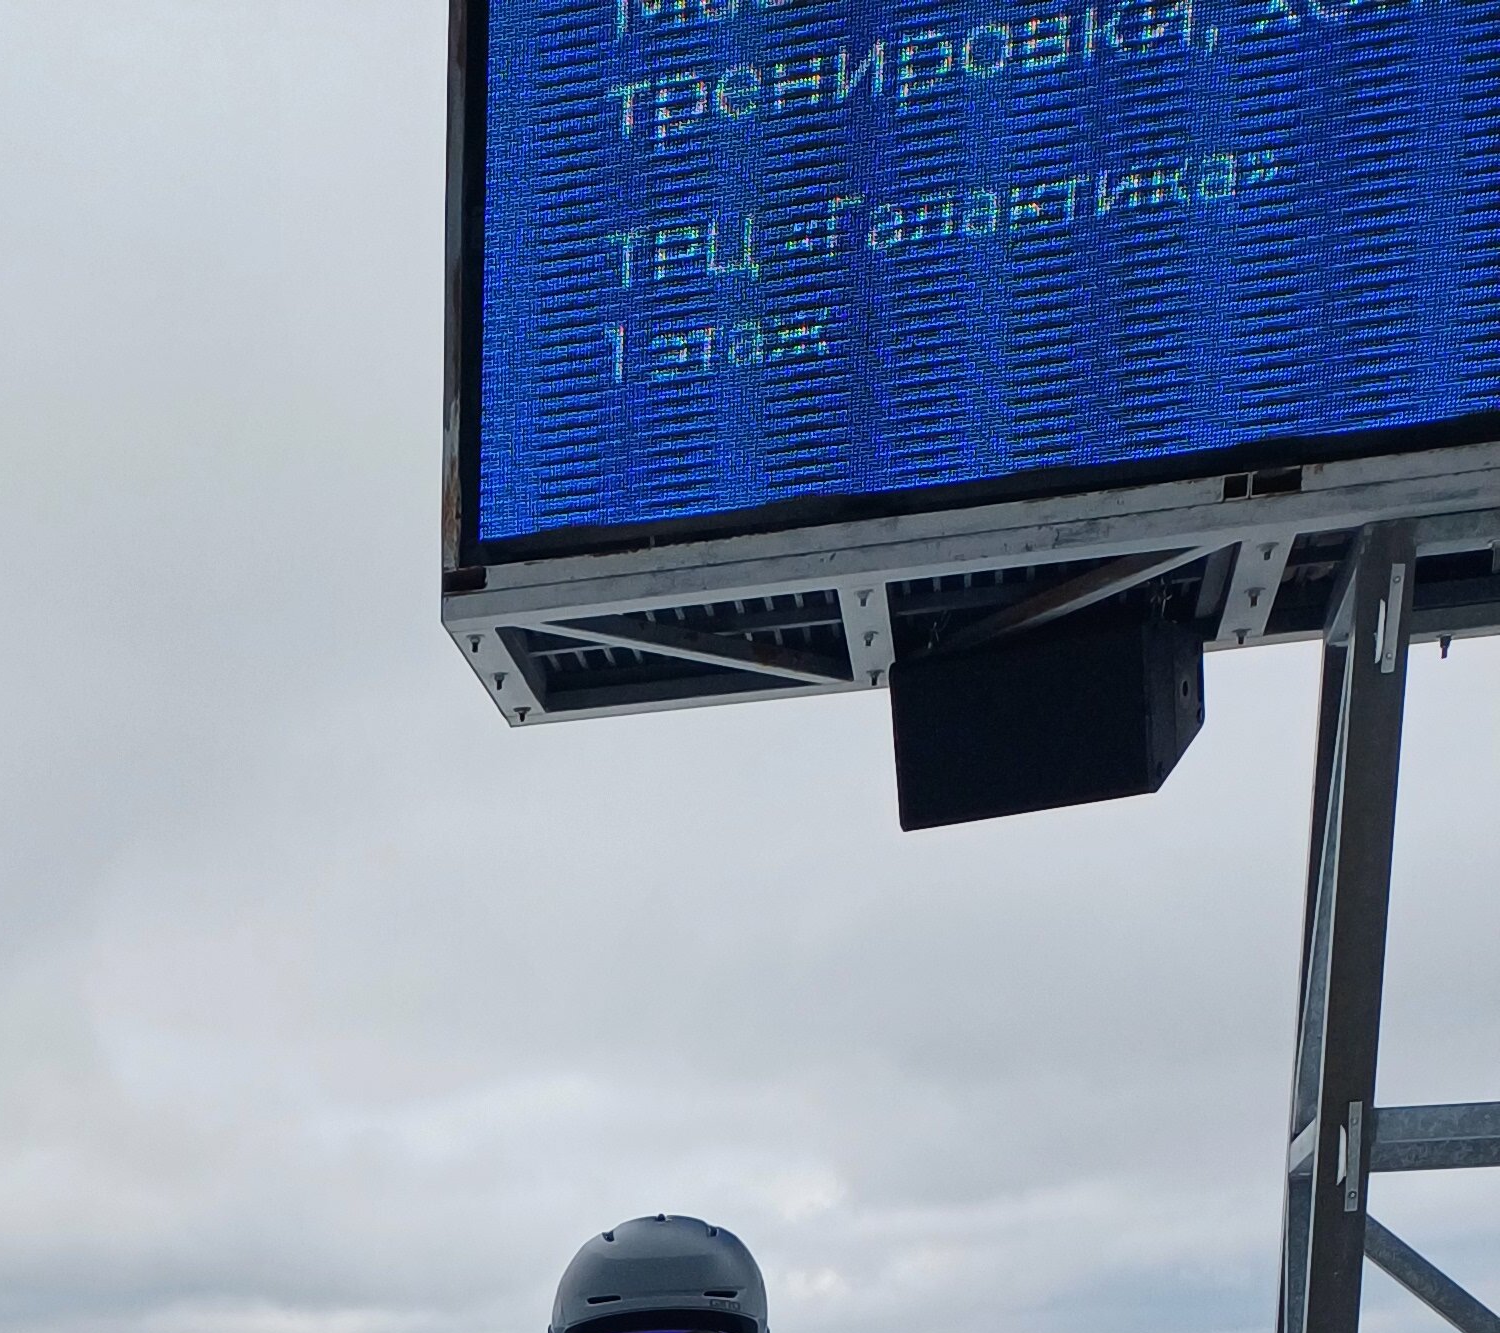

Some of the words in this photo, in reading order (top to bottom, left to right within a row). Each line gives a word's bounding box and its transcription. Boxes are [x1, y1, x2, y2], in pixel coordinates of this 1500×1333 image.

[607, 0, 1220, 149] тренировки,
[604, 207, 762, 288] ТРЦ
[603, 321, 627, 383] 1
[649, 308, 832, 381] этаж
